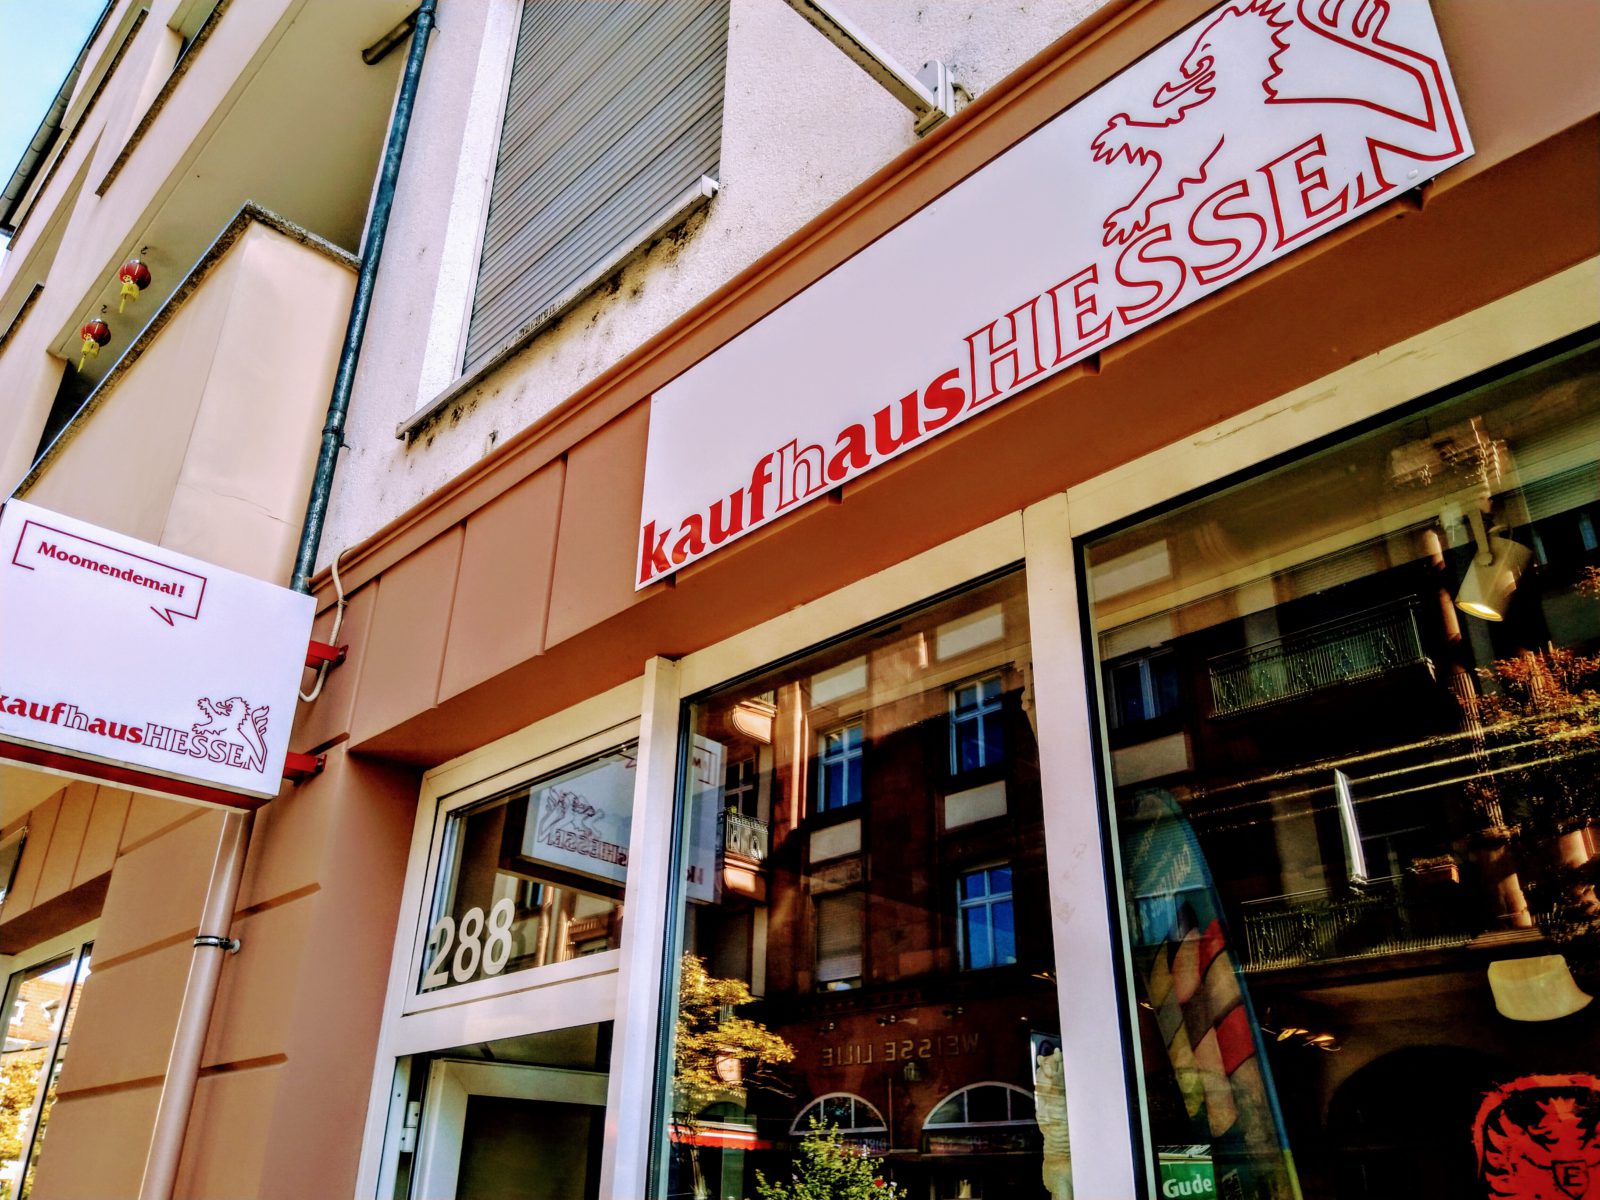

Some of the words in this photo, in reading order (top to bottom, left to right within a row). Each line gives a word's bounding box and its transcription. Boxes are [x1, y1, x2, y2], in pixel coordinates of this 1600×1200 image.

[37, 541, 185, 598] Moomendemal!
[421, 897, 516, 989] 288
[1162, 1173, 1213, 1199] Gude
[1563, 1166, 1584, 1186] E
